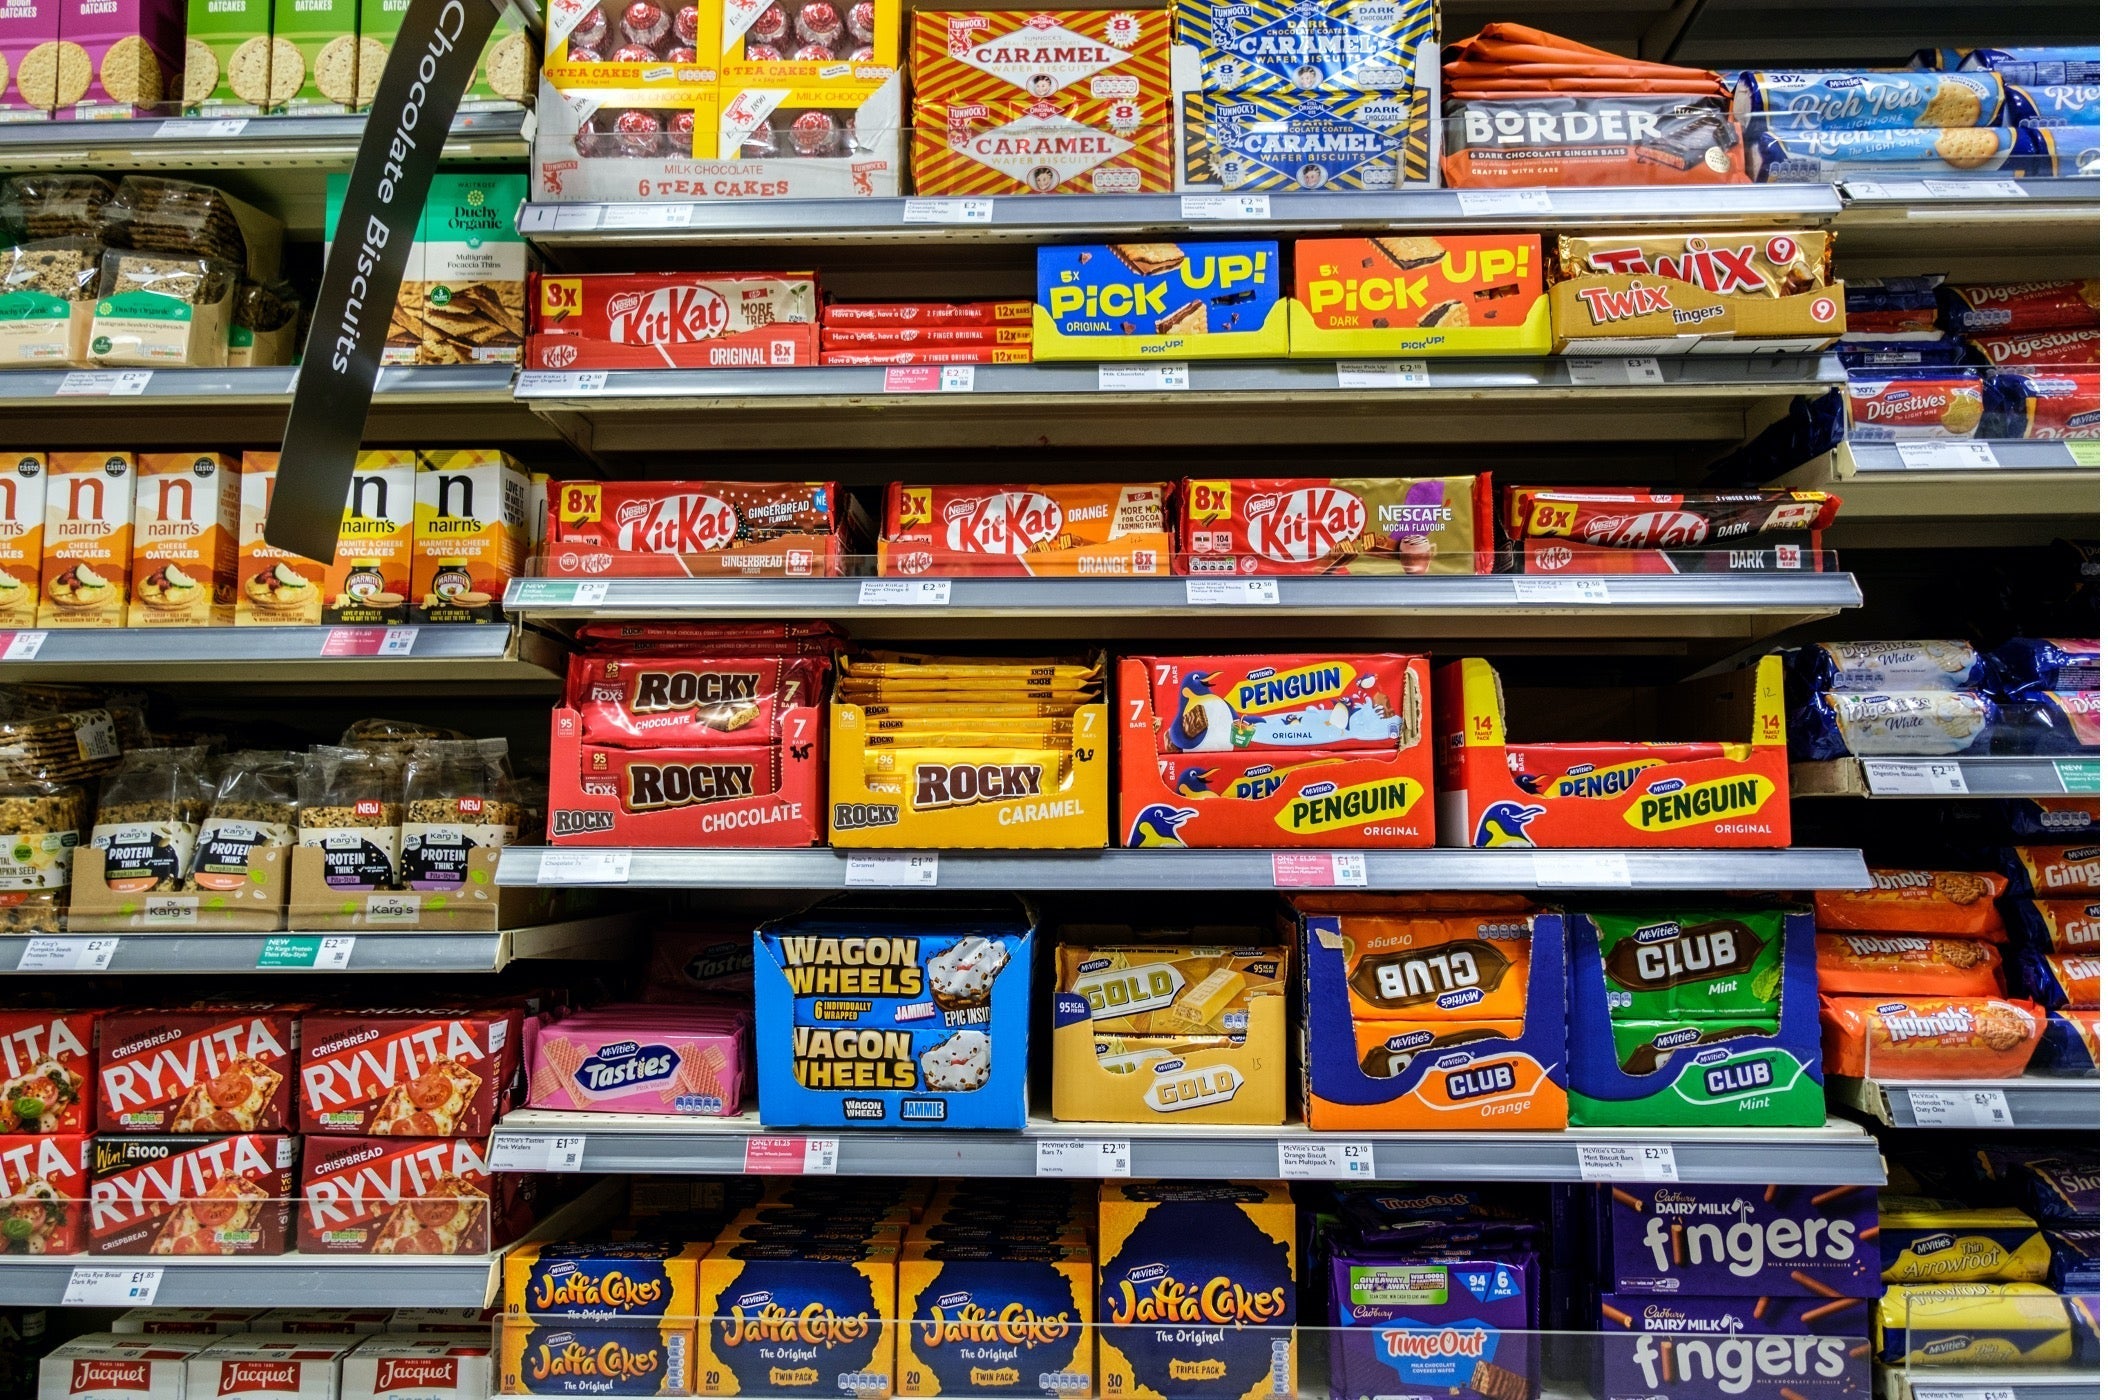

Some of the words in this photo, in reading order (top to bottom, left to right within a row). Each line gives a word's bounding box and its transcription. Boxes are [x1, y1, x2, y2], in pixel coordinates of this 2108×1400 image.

[80, 2, 117, 15] OATCAKES
[208, 0, 246, 12] OATCAKES
[1212, 6, 1254, 19] TUNNOCK'S
[1359, 5, 1395, 15] DARK
[949, 18, 989, 30] TUNNOCK'S
[1287, 20, 1328, 29] DARK
[1239, 35, 1378, 55] CARAMEL
[976, 47, 1110, 64] CARAMEL
[1255, 55, 1299, 64] WAFER
[1303, 55, 1361, 64] BISCUITS
[547, 69, 553, 78] 6
[558, 68, 588, 77] TEA
[592, 67, 639, 78] CAKES
[991, 64, 1035, 73] WAFER
[1038, 64, 1097, 73] BISCUITS
[1770, 75, 1806, 84] 30%
[377, 0, 465, 205] Chocolate
[1788, 90, 1863, 129] Rich
[1866, 81, 1923, 115] Tea
[1466, 110, 1662, 143] BORDER
[1506, 150, 1562, 158] CHOCOLATE
[664, 164, 692, 175] MILK
[694, 164, 763, 175] CHOCOLATE
[1472, 168, 1508, 176] CRAFTED
[639, 180, 649, 195] 6
[658, 181, 708, 195] TEA
[714, 180, 789, 196] CAKES
[454, 205, 502, 220] Duchy
[447, 216, 503, 232] Organic
[456, 253, 493, 261] Multigrain
[481, 261, 501, 269] Thins
[1441, 245, 1530, 282] UP!
[1179, 251, 1268, 290] UP!
[331, 213, 390, 375] Biscuits
[546, 283, 576, 307] 8x
[621, 287, 722, 344] KitKat
[740, 303, 774, 315] MORE
[1672, 304, 1723, 324] fingers
[744, 313, 775, 324] TREES
[1066, 321, 1112, 332] ORIGINAL
[1329, 315, 1360, 327] DARK
[999, 330, 1016, 341] 12x
[709, 347, 764, 366] ORIGINAL
[1866, 395, 1946, 420] Digestives
[566, 491, 597, 515] 8x
[748, 499, 811, 521] GINGERBREAD
[767, 515, 793, 524] FLAVOUR
[1067, 503, 1108, 523] ORANGE
[59, 520, 111, 536] nairn's
[428, 518, 481, 533] nairn's
[1382, 523, 1410, 532] MOCHA
[1412, 522, 1446, 532] FLAVOUR
[56, 549, 111, 559] OATCAKES
[427, 546, 481, 557] OATCAKES
[1729, 550, 1765, 570] DARK
[721, 555, 783, 569] GINGERBREAD
[1078, 557, 1129, 573] ORANGE
[605, 663, 619, 672] 95
[639, 671, 760, 709] ROCKY
[1239, 667, 1342, 709] PENGUIN
[635, 715, 690, 732] CHOCOLATE
[792, 719, 803, 739] 7
[1472, 715, 1493, 732] 14
[1885, 717, 1924, 730] White
[1271, 730, 1313, 740] ORIGINAL
[628, 764, 754, 808] ROCKY
[914, 764, 1042, 806] ROCKY
[357, 803, 378, 814] NEW
[460, 800, 480, 810] NEW
[1291, 784, 1407, 828] PENGUIN
[1640, 780, 1757, 827] PENGUIN
[702, 803, 802, 833] CHOCOLATE
[997, 799, 1084, 826] CARAMEL
[1363, 825, 1419, 837] ORIGINAL
[108, 846, 154, 860] PROTEIN
[421, 849, 465, 861] PROTEIN
[150, 906, 192, 918] Karg's
[783, 937, 918, 967] WAGON
[1633, 936, 1736, 980] CLUB
[784, 966, 922, 997] WHEELS
[823, 1001, 872, 1013] INDIVIDUALLY
[823, 1010, 858, 1021] WRAPPED
[894, 1001, 935, 1022] JAMMIE
[1884, 1006, 1974, 1042] Hobnobs
[111, 1028, 182, 1059] CRISPBREAD
[1389, 1032, 1431, 1051] McVitie's
[101, 1018, 287, 1114] RYVITA
[301, 1020, 485, 1113] RYVITA
[584, 1051, 671, 1091] Tasties
[1447, 1066, 1513, 1093] CLUB
[1705, 1060, 1770, 1090] CLUB
[1156, 1067, 1236, 1105] GOLD
[903, 1101, 944, 1118] JAMMIE
[1481, 1099, 1532, 1118] Orange
[1737, 1095, 1770, 1112] Mint
[95, 1142, 127, 1169] Win!
[127, 1143, 169, 1159] £1000
[1655, 1203, 1696, 1214] DAIRY
[1699, 1203, 1731, 1214] MILK
[1904, 1247, 2000, 1279] Arrowroot
[1469, 1275, 1486, 1286] 94
[1108, 1277, 1201, 1329] Jaffa
[1200, 1276, 1285, 1331] Cakes
[1353, 1305, 1393, 1319] Cadbury
[721, 1303, 798, 1347] Jaffa
[798, 1305, 869, 1350] Cakes
[1155, 1329, 1175, 1342] The
[1178, 1328, 1224, 1345] Original
[74, 1362, 146, 1388] Jacquet
[221, 1361, 294, 1388] Jacquet
[774, 1372, 791, 1382] TWIN
[793, 1372, 813, 1382] PACK
[1175, 1363, 1198, 1376] TRIPLE
[1201, 1364, 1220, 1376] PACK
[1107, 1374, 1122, 1388] 30
